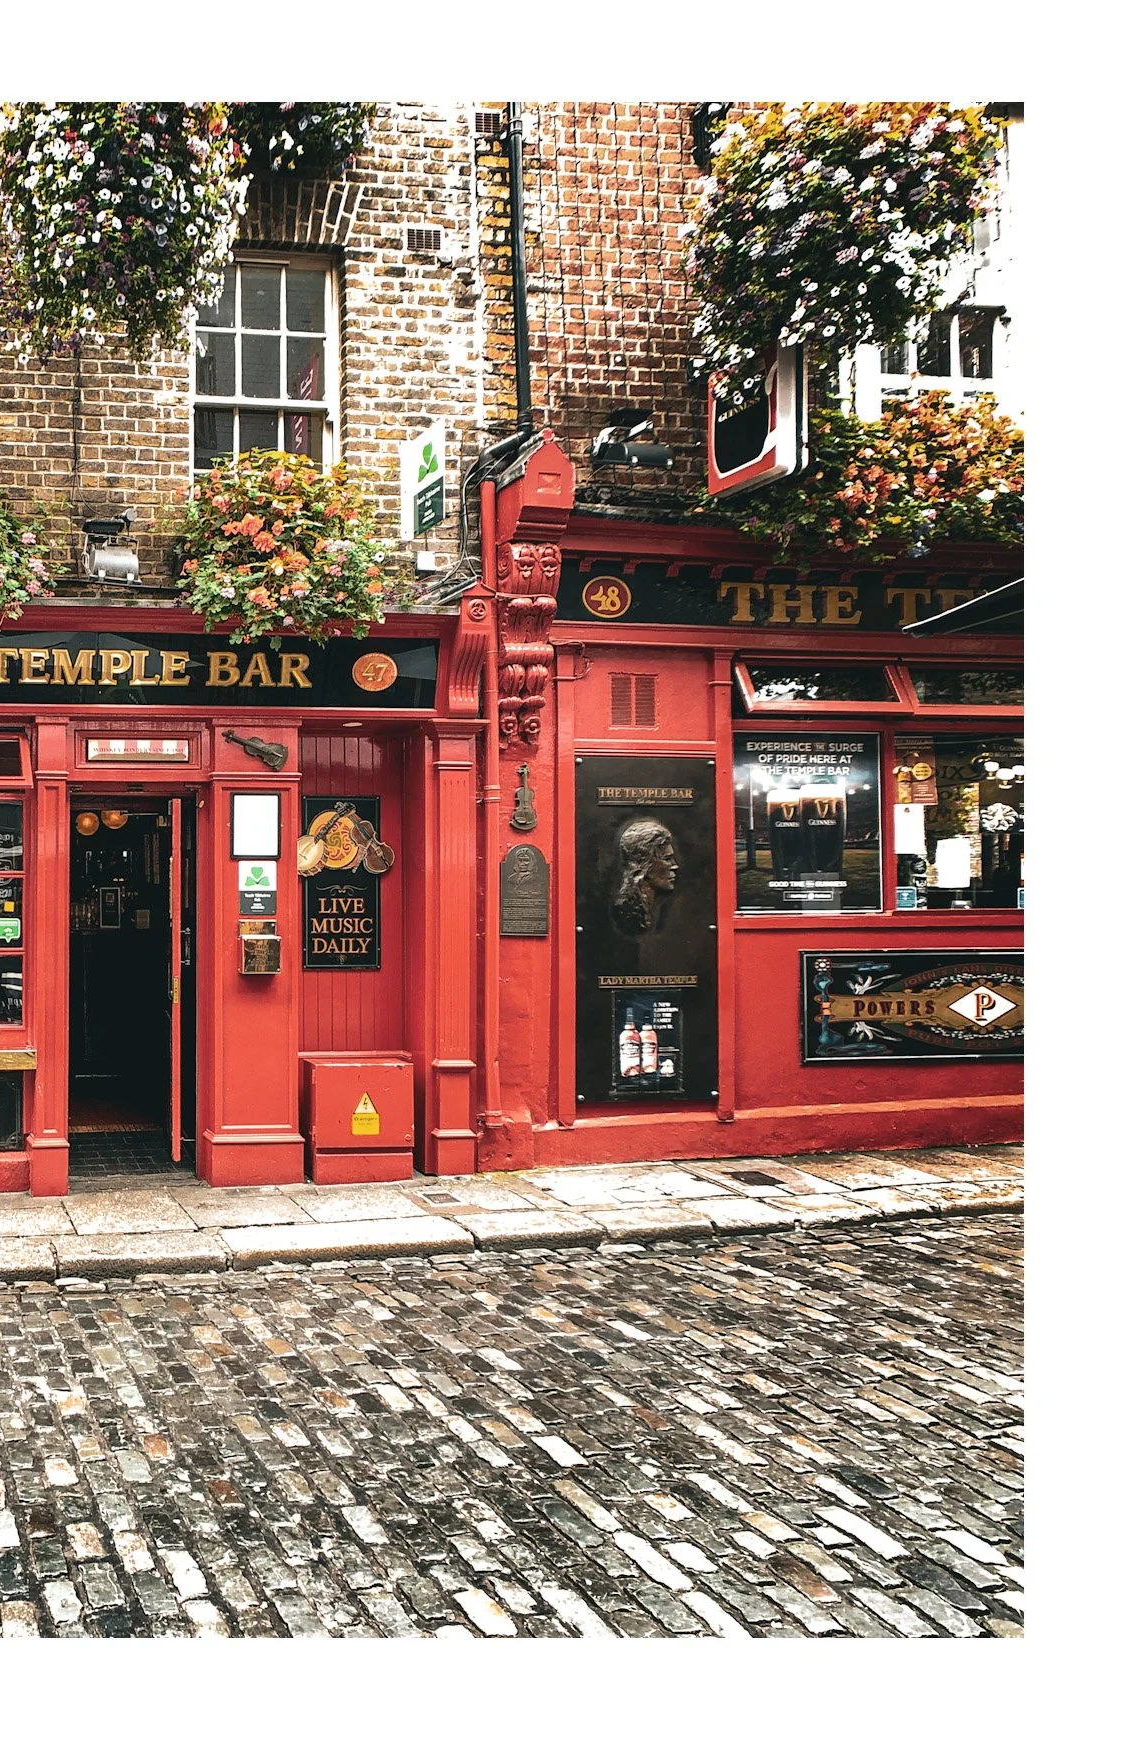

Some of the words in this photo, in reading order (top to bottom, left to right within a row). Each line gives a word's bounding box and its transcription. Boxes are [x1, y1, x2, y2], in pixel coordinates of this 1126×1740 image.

[590, 585, 621, 611] 48
[720, 582, 862, 625] THE
[205, 651, 313, 688] BAR
[361, 662, 389, 682] 47
[746, 742, 812, 751] EXPERIENCE
[816, 743, 826, 751] THE
[829, 742, 864, 752] SURGE
[758, 754, 773, 763] OF
[776, 754, 807, 763] PRIDE
[810, 754, 837, 763] HERE
[839, 755, 853, 763] AT
[764, 766, 783, 775] THE
[785, 766, 826, 775] TEMPLE
[828, 767, 850, 776] BAR
[598, 788, 622, 798] THE
[624, 788, 668, 798] TEMPLE
[670, 789, 694, 799] BAR
[318, 898, 365, 914] LIVE
[311, 918, 373, 934] MUSIC
[312, 938, 372, 954] DAILY
[600, 976, 623, 985] LADY
[624, 976, 662, 985] MARTHA
[662, 976, 697, 984] TEMPLE
[853, 1000, 935, 1017] POWERS
[974, 993, 996, 1018] P
